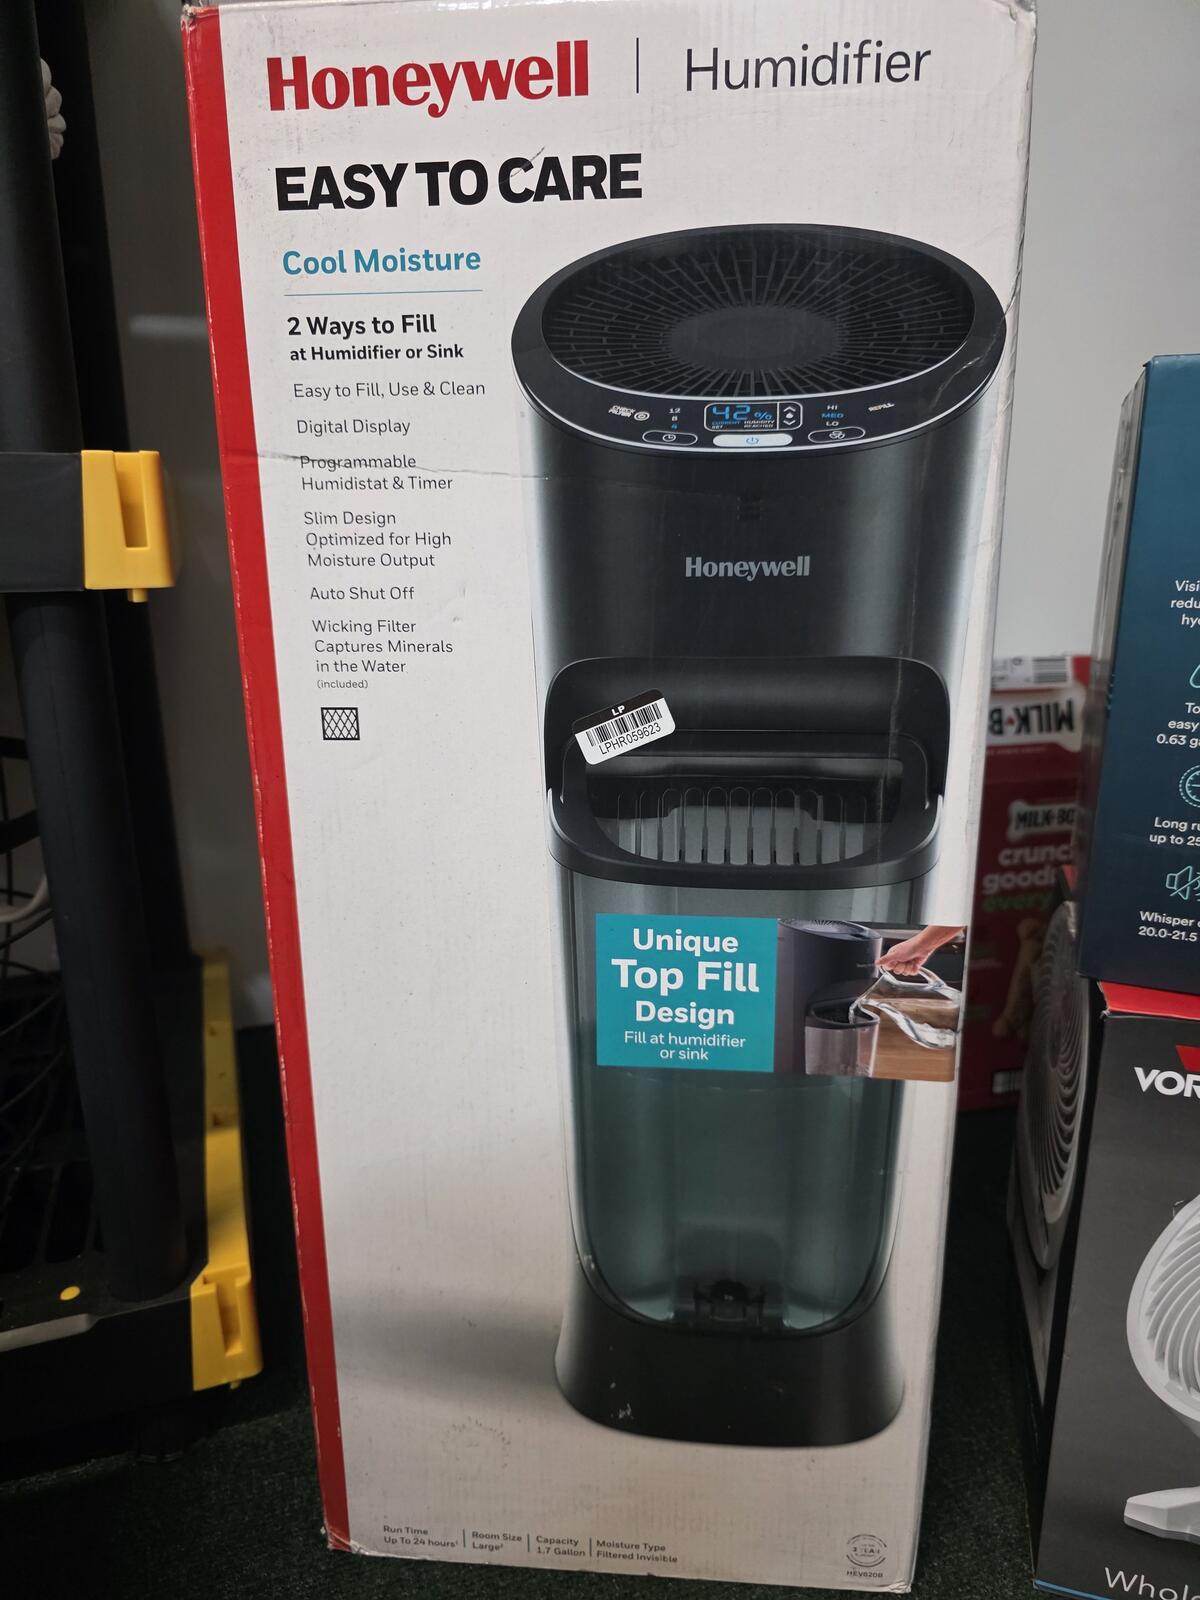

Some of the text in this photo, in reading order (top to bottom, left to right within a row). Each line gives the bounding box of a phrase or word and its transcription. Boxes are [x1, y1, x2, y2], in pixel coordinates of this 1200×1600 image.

[686, 39, 932, 92] Humidifier
[266, 39, 589, 118] Honeywell
[274, 152, 643, 212] EASY TO CARE
[282, 246, 482, 276] Cool Moisture
[287, 313, 437, 340] 2 Ways to Fill
[290, 343, 465, 361] at Humidifier or Sink
[293, 380, 486, 401] Easy to Fill, Use & Clean
[711, 404, 752, 421] 42
[296, 419, 411, 437] Digital Display
[300, 454, 417, 472] Programmable
[301, 475, 453, 491] Humidistat & Timer
[303, 511, 396, 528] Slim Design
[305, 532, 452, 549] Optimized for High
[307, 553, 436, 570] Moisture Output
[684, 555, 810, 582] Honeywell
[310, 586, 415, 600] Auto Shut Off
[1175, 579, 1200, 592] Visi
[311, 619, 417, 636] Wicking Filter
[314, 639, 454, 656] Captures Minerals
[316, 659, 407, 673] in the Water
[316, 679, 369, 690] (included)
[611, 704, 626, 717] LP
[1167, 720, 1200, 733] easy
[598, 721, 662, 756] LPHR059623
[1156, 733, 1187, 746] 0.63
[1154, 816, 1188, 833] Long
[1149, 833, 1167, 846] up
[1169, 833, 1184, 846] to
[1139, 910, 1195, 928] Whisper
[1138, 925, 1198, 942] 20.0-21.5
[632, 928, 739, 957] Unique
[610, 958, 760, 996] Top Fill
[634, 1000, 736, 1030] Design
[624, 1030, 746, 1049] Fill at humidifier
[659, 1047, 709, 1061] or sink
[383, 1525, 429, 1536] Run Time
[471, 1530, 522, 1542] Room Size
[383, 1536, 398, 1545] Up
[400, 1536, 411, 1545] To
[413, 1537, 426, 1546] 24
[535, 1535, 580, 1547] Capacity
[596, 1539, 666, 1552] Moisture Type
[537, 1546, 586, 1557] 1.7 Gallon
[596, 1550, 678, 1563] Filtered Invisible
